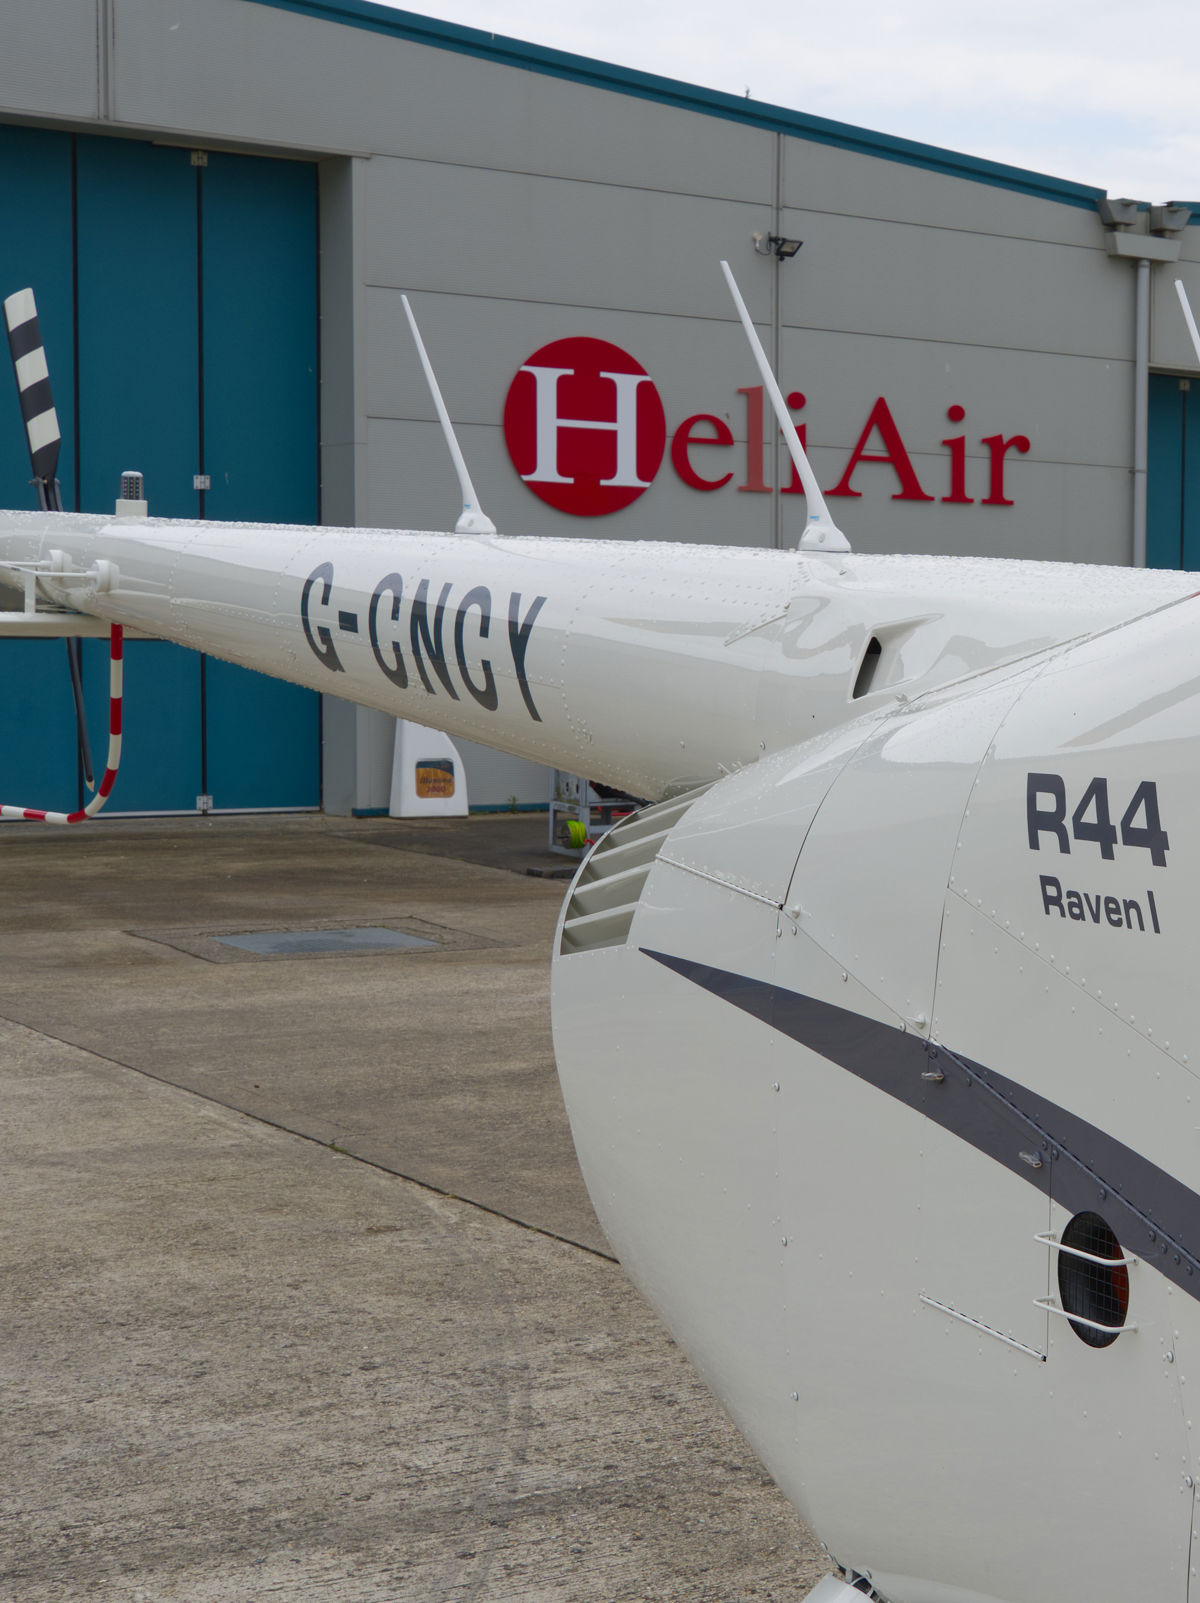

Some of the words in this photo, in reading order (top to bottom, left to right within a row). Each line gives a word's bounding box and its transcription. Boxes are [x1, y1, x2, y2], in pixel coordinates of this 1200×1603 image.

[511, 345, 1031, 512] HeliAir
[301, 561, 548, 722] G-CNCY
[1027, 772, 1170, 868] R44
